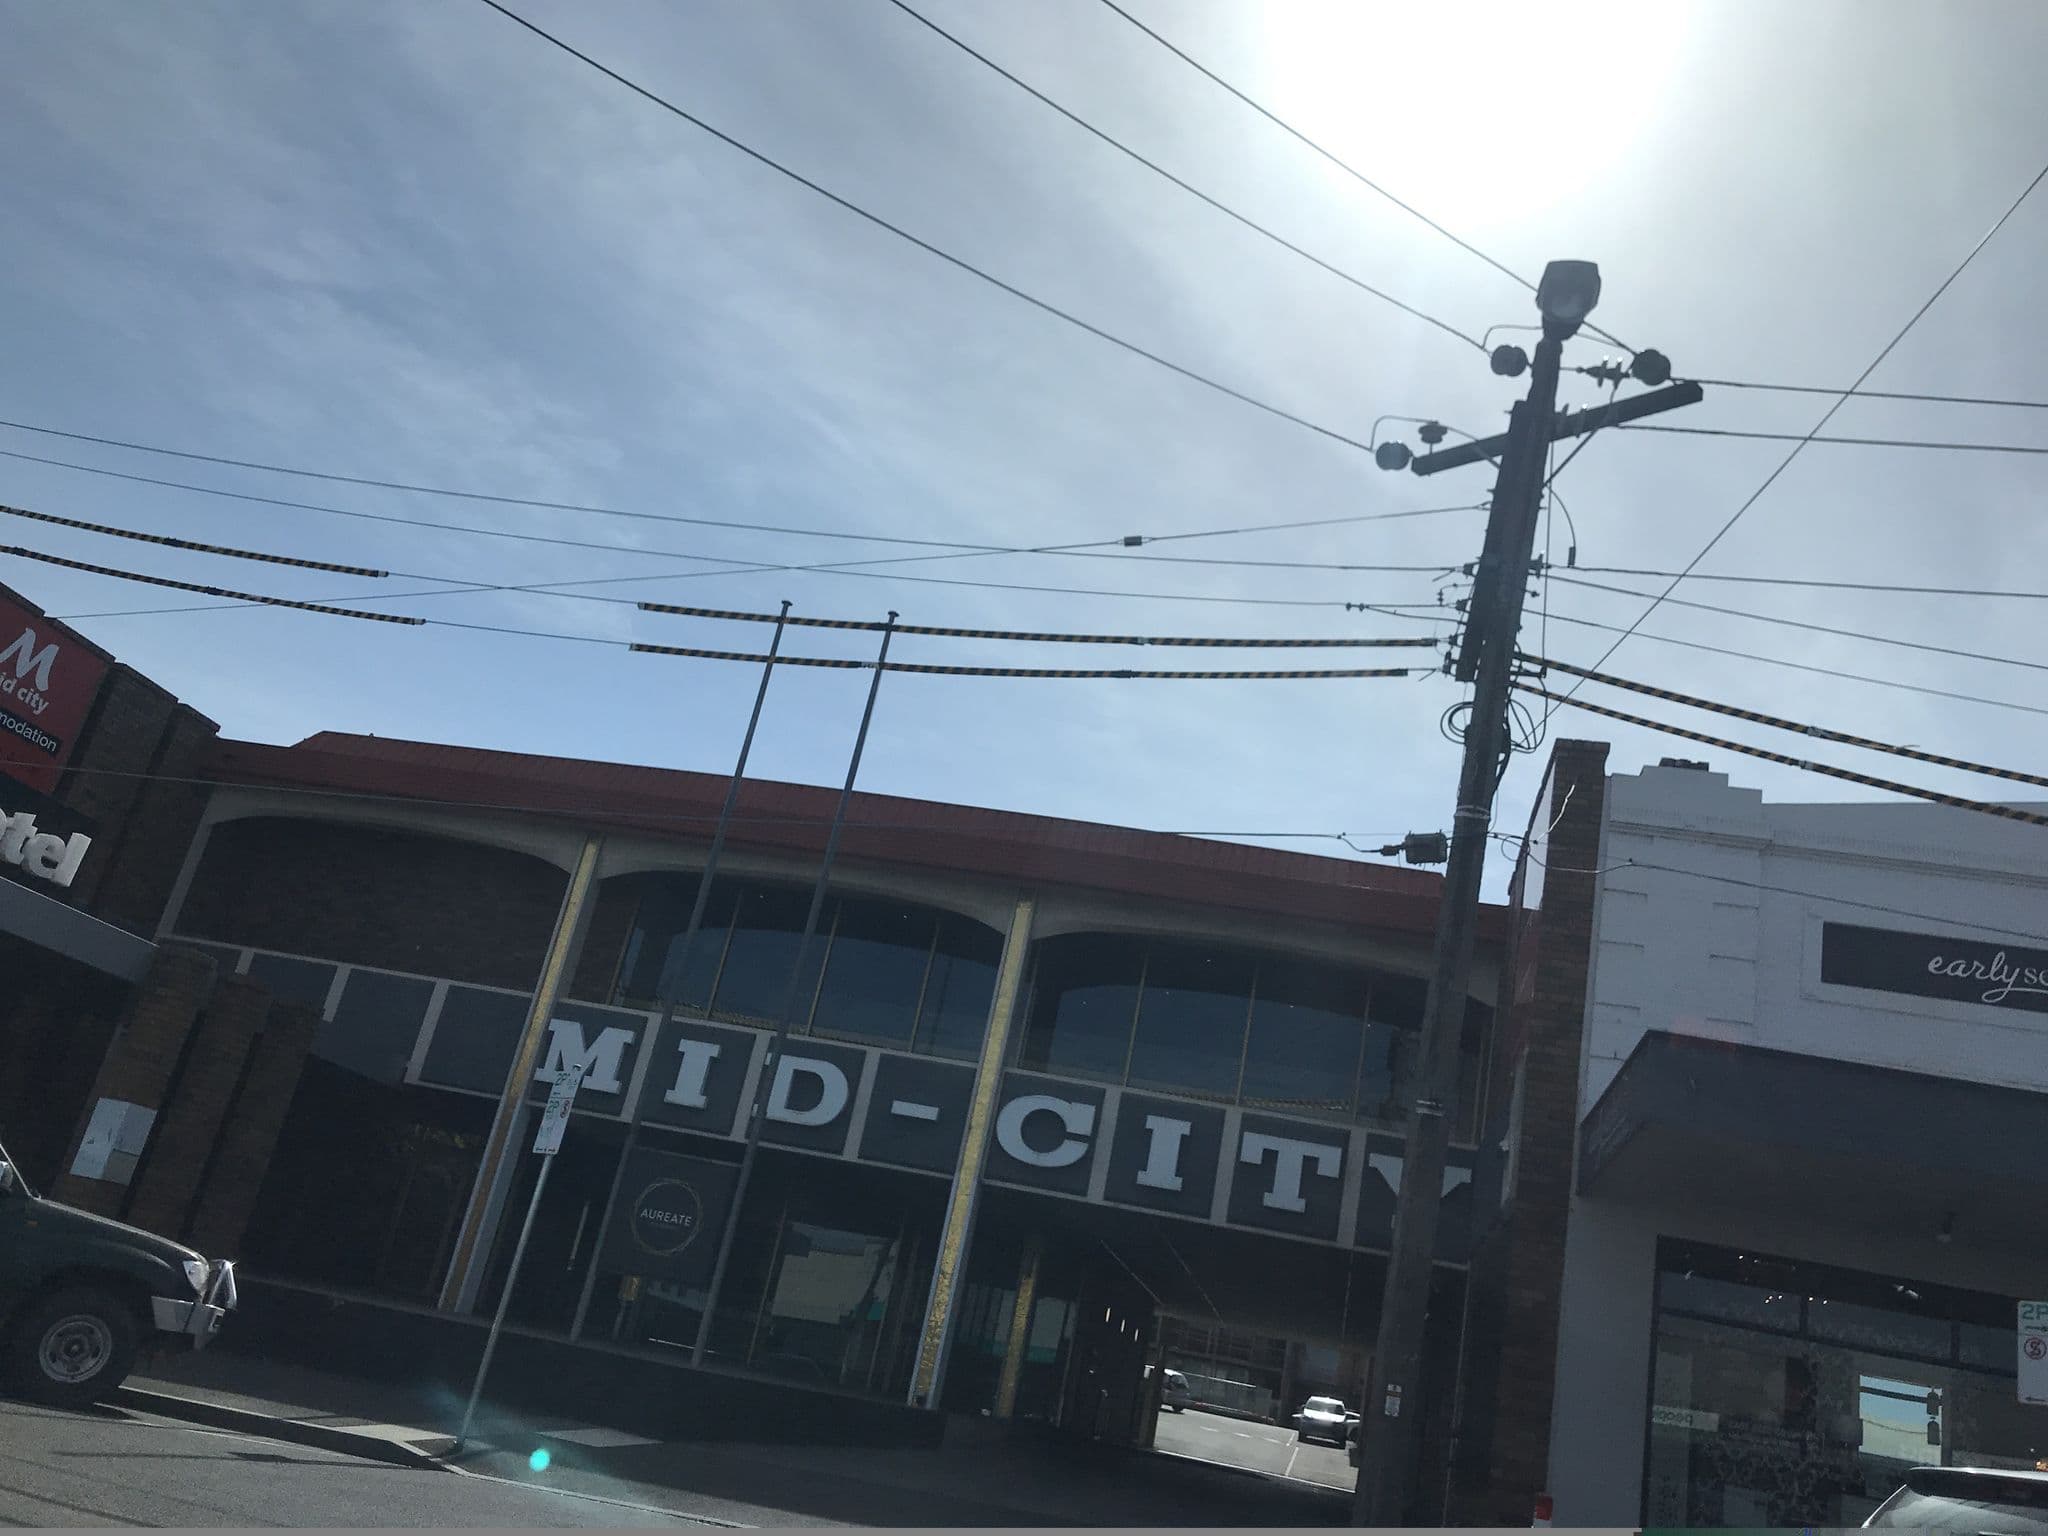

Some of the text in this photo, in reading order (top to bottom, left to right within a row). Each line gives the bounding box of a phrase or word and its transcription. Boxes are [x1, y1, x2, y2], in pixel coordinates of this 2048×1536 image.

[17, 688, 50, 716] city
[0, 808, 92, 887] tel
[640, 1208, 692, 1227] AUREATE
